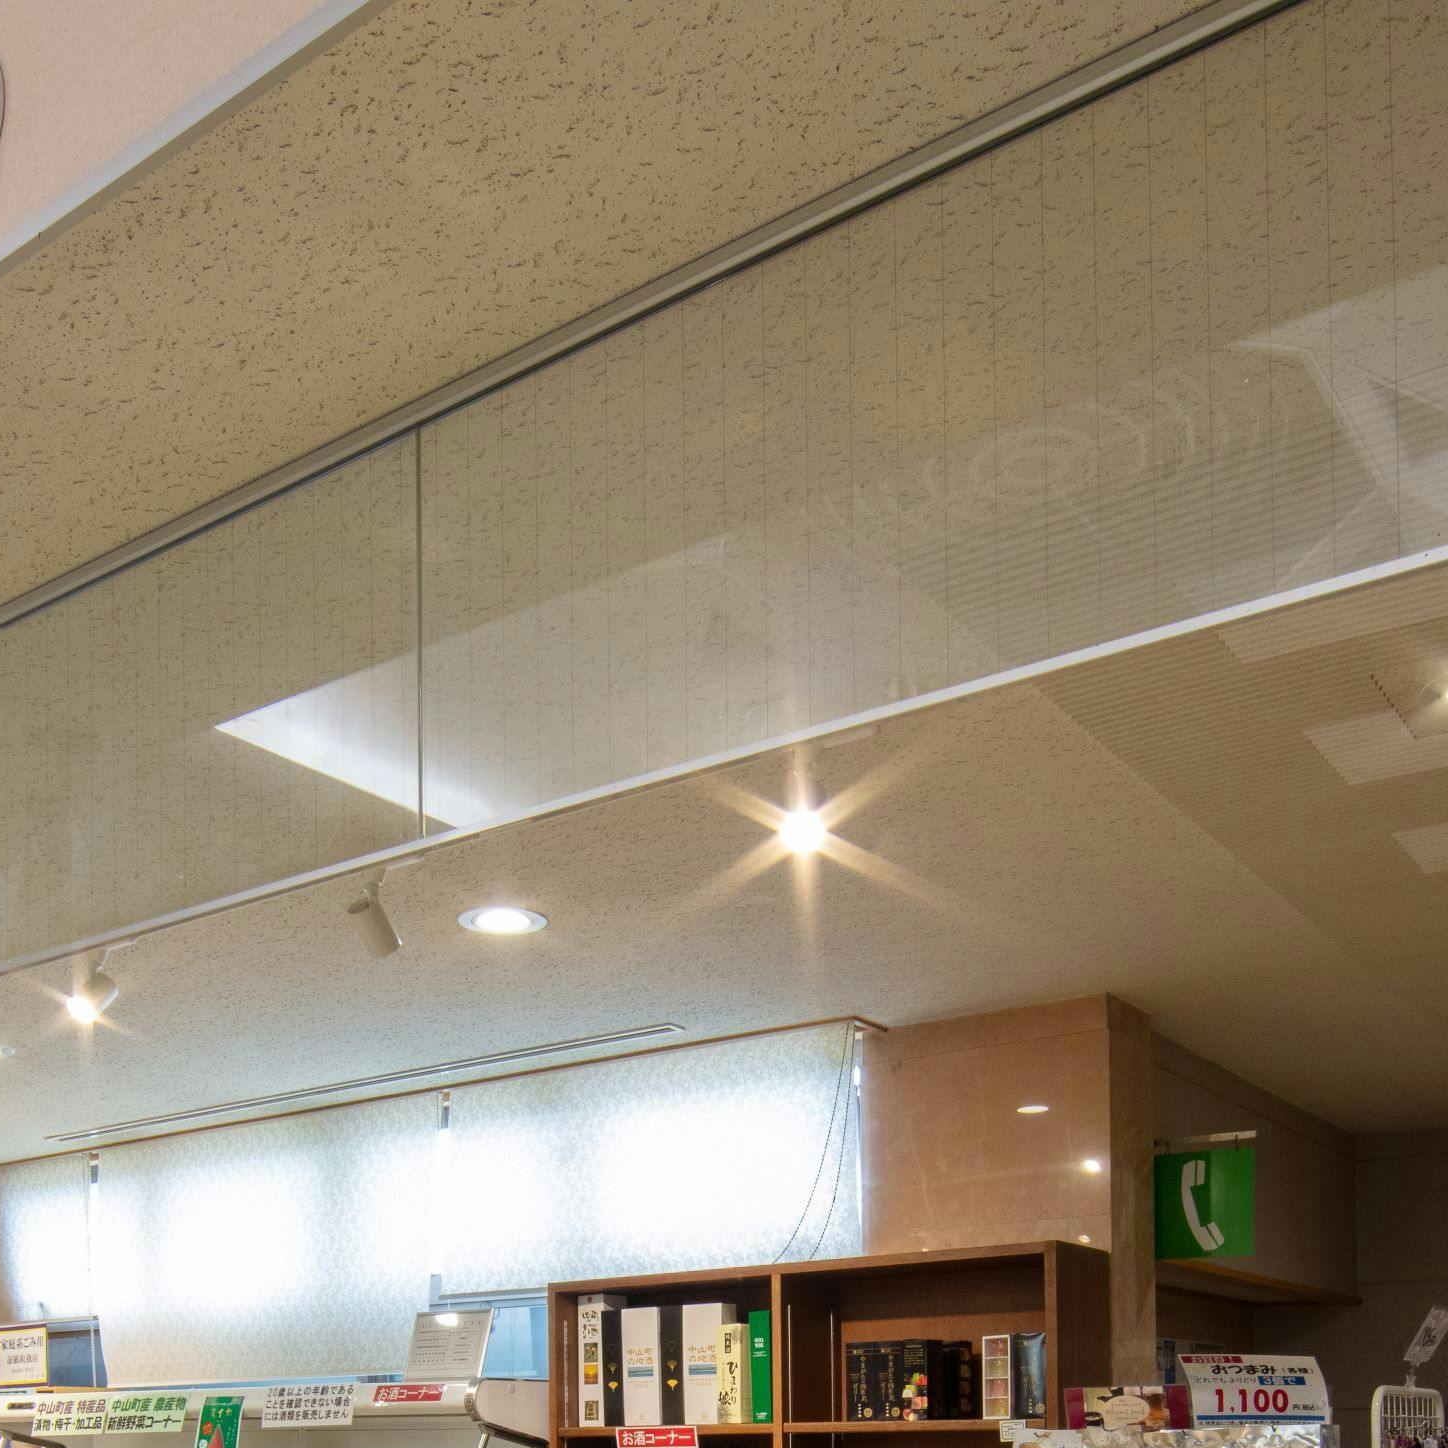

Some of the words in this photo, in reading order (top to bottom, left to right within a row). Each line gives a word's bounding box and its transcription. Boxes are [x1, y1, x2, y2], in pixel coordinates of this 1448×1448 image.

[0, 1335, 44, 1351] 家庭系ごみ用
[6, 1354, 38, 1365] 証紙取扱店
[1212, 1364, 1277, 1375] おつまみ
[1195, 1376, 1226, 1384] どれでも
[268, 1384, 354, 1398] 20歳以上の年齢である
[377, 1386, 441, 1400] お酒コーナー
[37, 1401, 74, 1415] 中山町産
[76, 1399, 106, 1413] 特産品
[112, 1398, 152, 1412] 中山町産
[153, 1397, 186, 1411] 農産物
[265, 1397, 350, 1409] ことを確認できない場合
[1215, 1389, 1289, 1413] 1,100
[264, 1409, 348, 1421] には酒類を販売しません
[107, 1416, 181, 1430] 新鮮野菜コーナー
[622, 1431, 691, 1446] お酒コーナー
